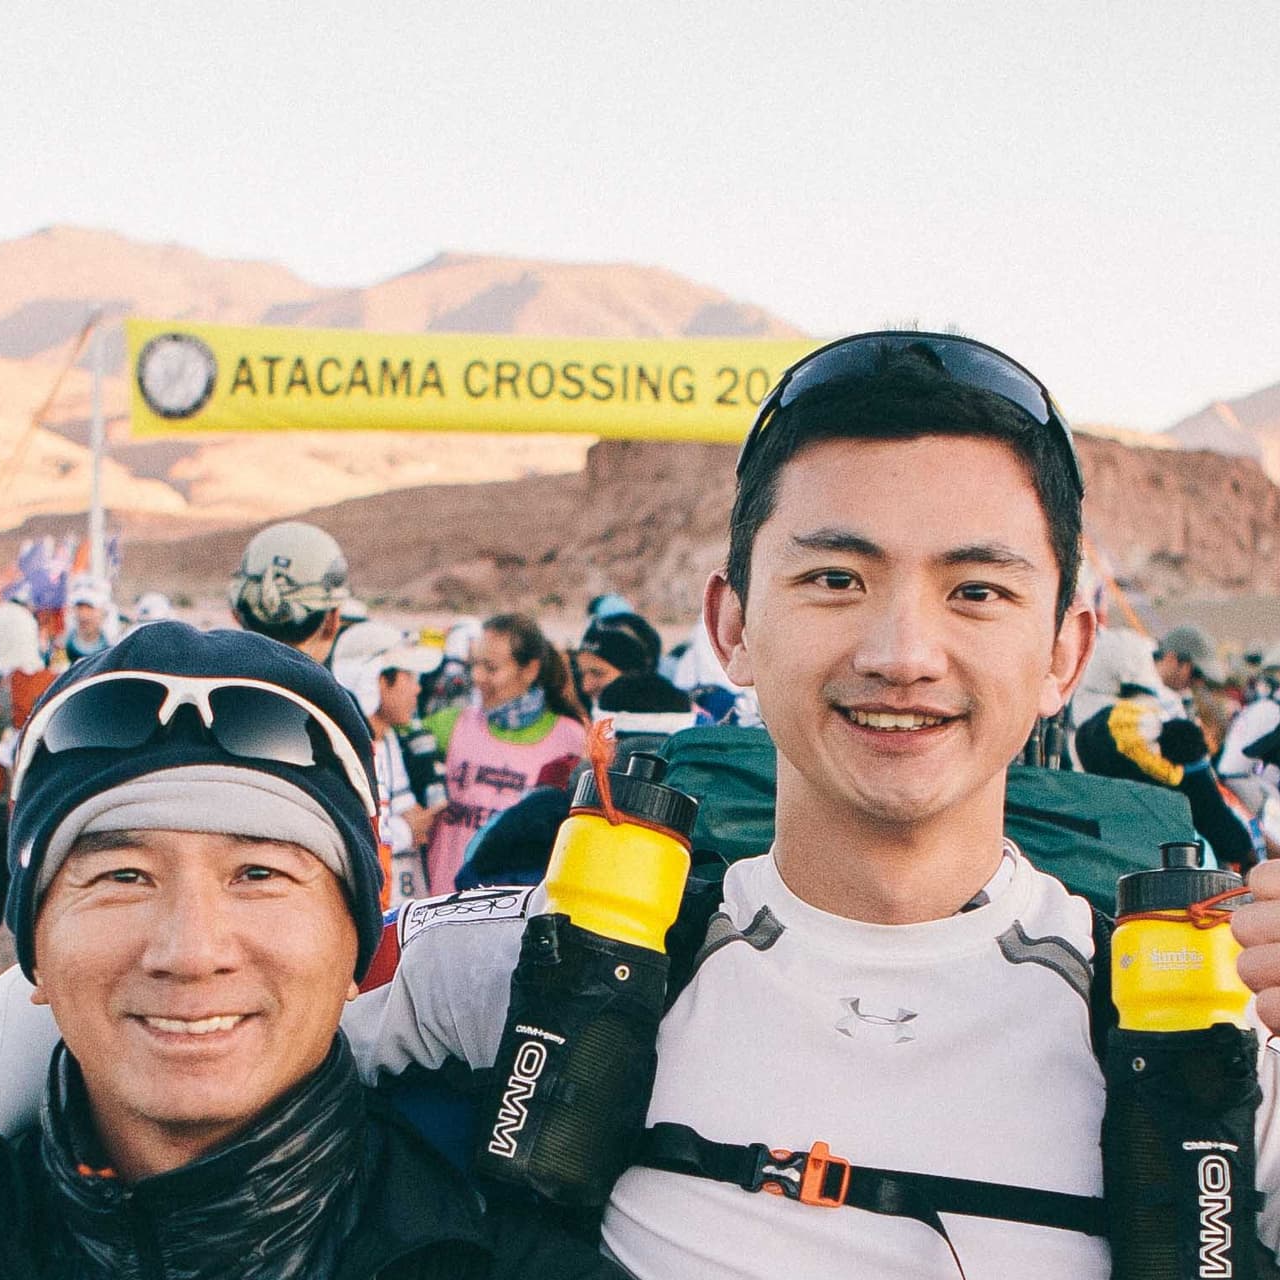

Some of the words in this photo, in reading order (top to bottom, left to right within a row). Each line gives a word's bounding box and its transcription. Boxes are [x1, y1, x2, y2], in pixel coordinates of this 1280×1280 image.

[231, 356, 445, 398] ATACAMA
[463, 361, 696, 404] CROSSING
[715, 367, 771, 407] 20
[488, 1041, 547, 1158] OMM
[1197, 1154, 1232, 1278] OMM
